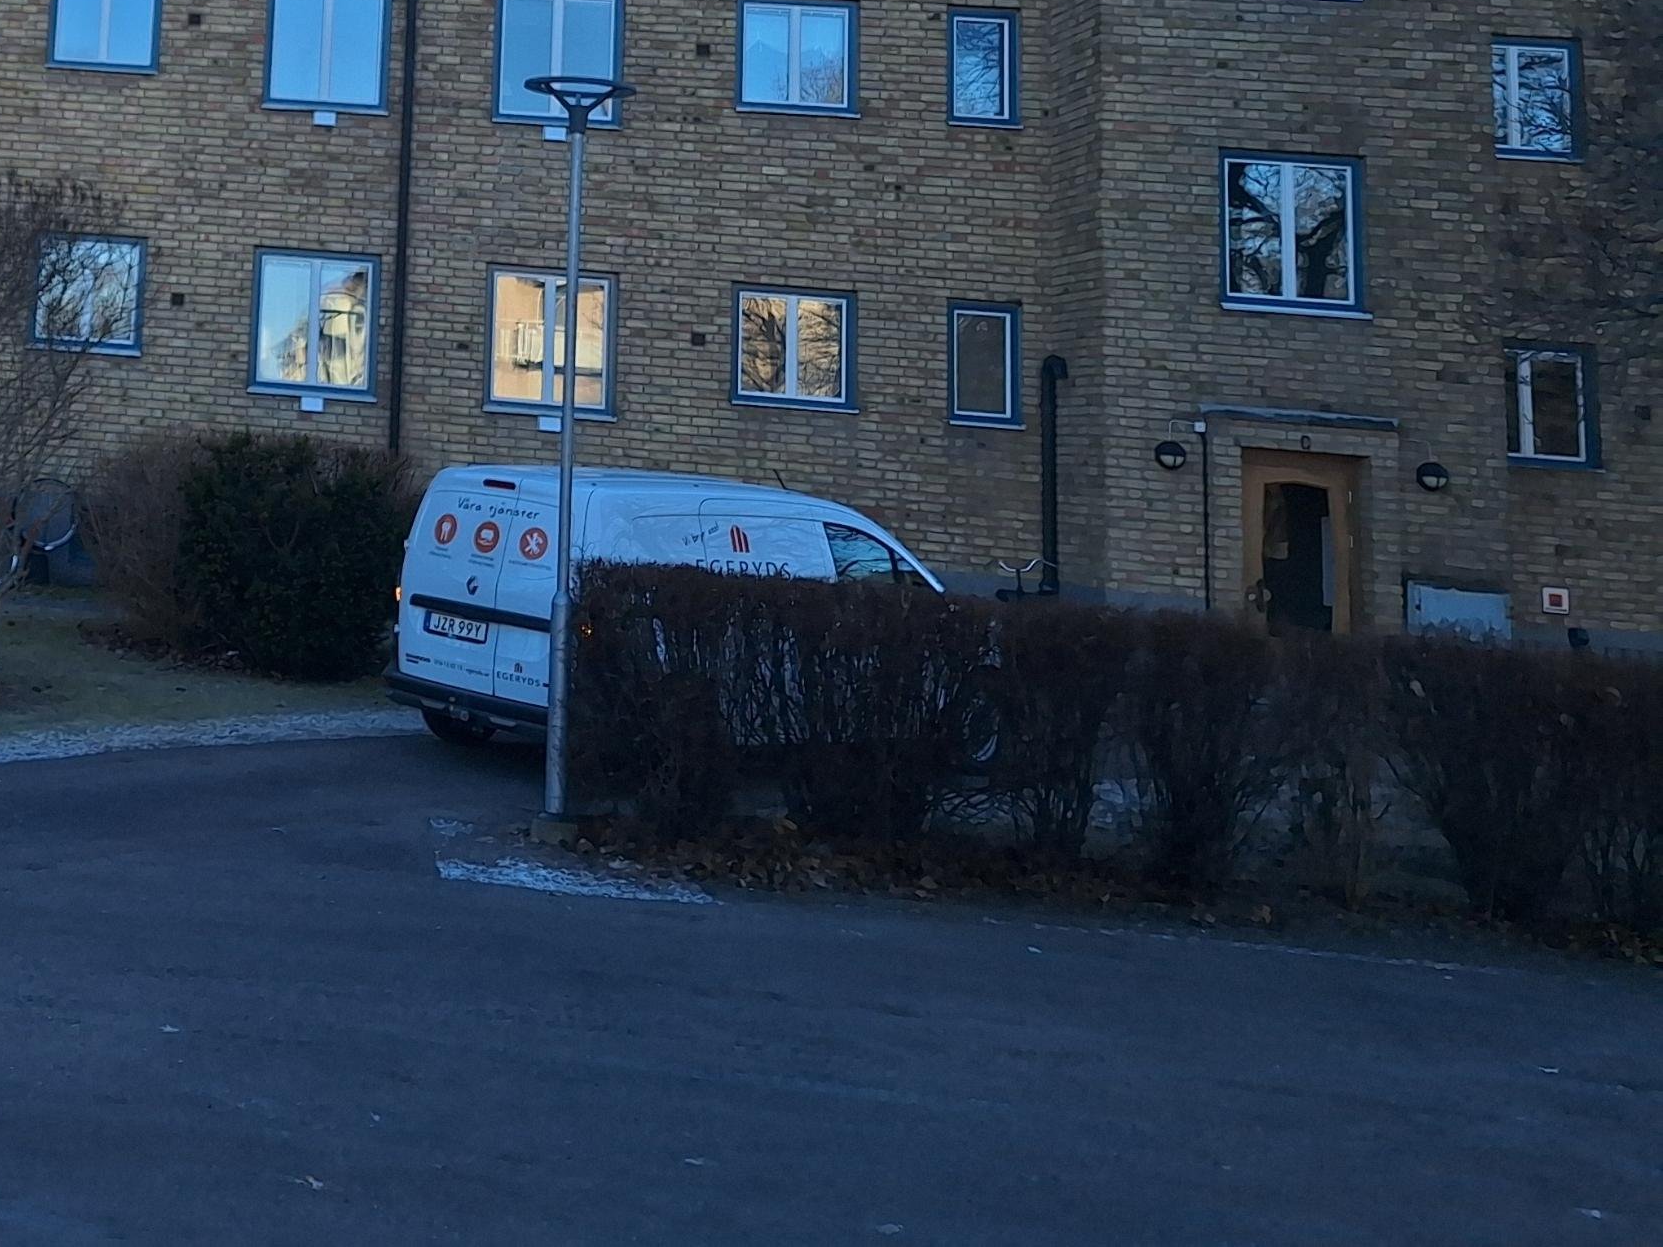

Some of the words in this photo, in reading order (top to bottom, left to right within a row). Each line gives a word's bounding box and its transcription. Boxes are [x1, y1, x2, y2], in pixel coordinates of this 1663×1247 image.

[458, 497, 482, 511] Våra
[434, 615, 455, 634] JZR
[459, 621, 482, 638] 99Y
[496, 670, 541, 687] EGERYDS
